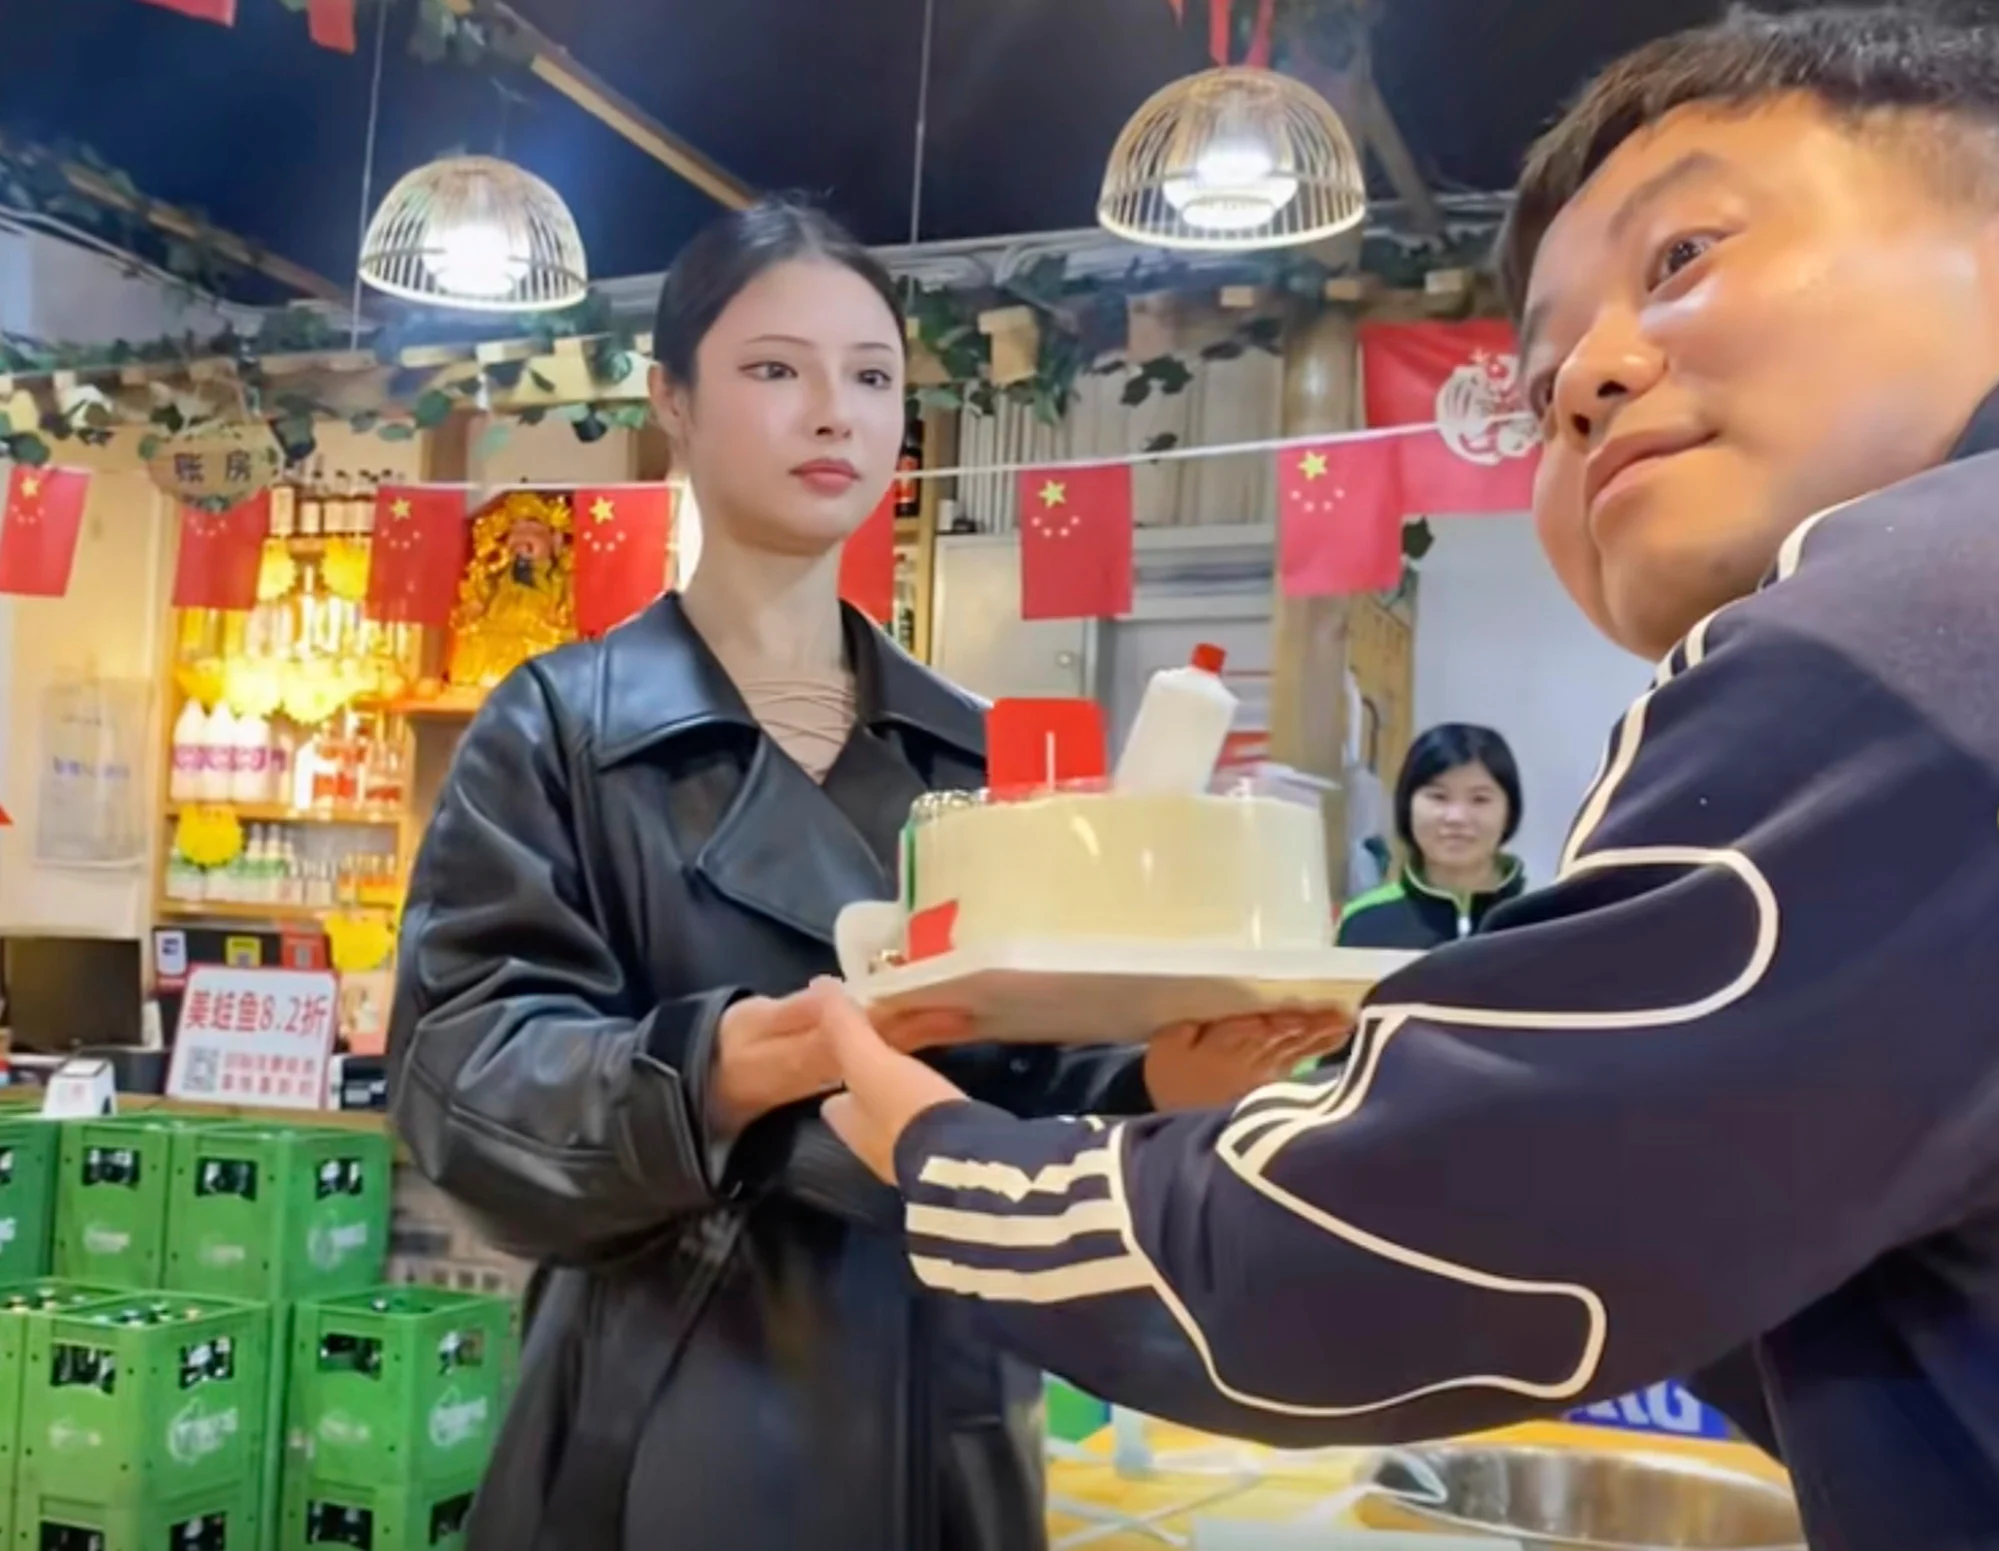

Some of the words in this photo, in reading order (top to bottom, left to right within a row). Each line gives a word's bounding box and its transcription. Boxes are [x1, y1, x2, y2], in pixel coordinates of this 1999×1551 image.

[174, 450, 252, 483] 账房
[184, 989, 329, 1041] 美蛙鱼8.2折
